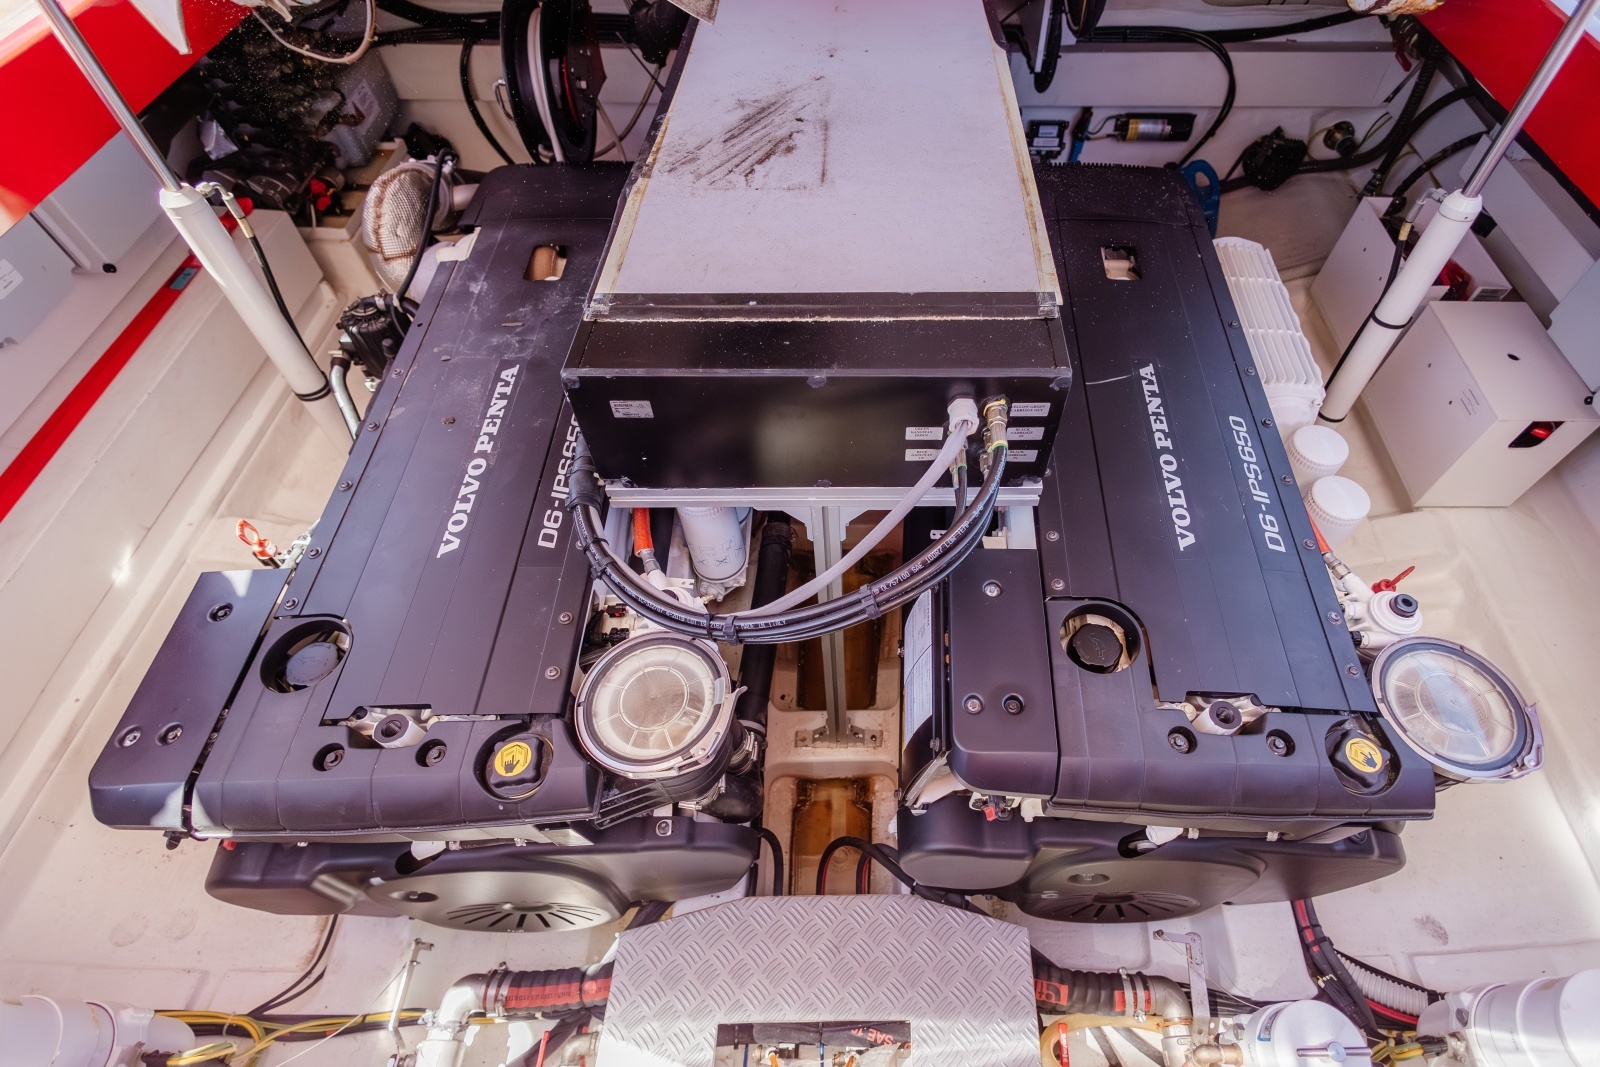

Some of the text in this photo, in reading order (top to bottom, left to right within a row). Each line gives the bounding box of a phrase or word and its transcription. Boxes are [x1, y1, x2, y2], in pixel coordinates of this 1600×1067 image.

[436, 364, 520, 558] VOLVO PENTA
[1139, 363, 1196, 551] VOLVO PENTA
[1229, 416, 1286, 552] D6-IPS650
[911, 562, 924, 574] SAE
[925, 545, 944, 565] 100R7
[768, 620, 787, 628] ITALY
[866, 1028, 894, 1046] SAE
